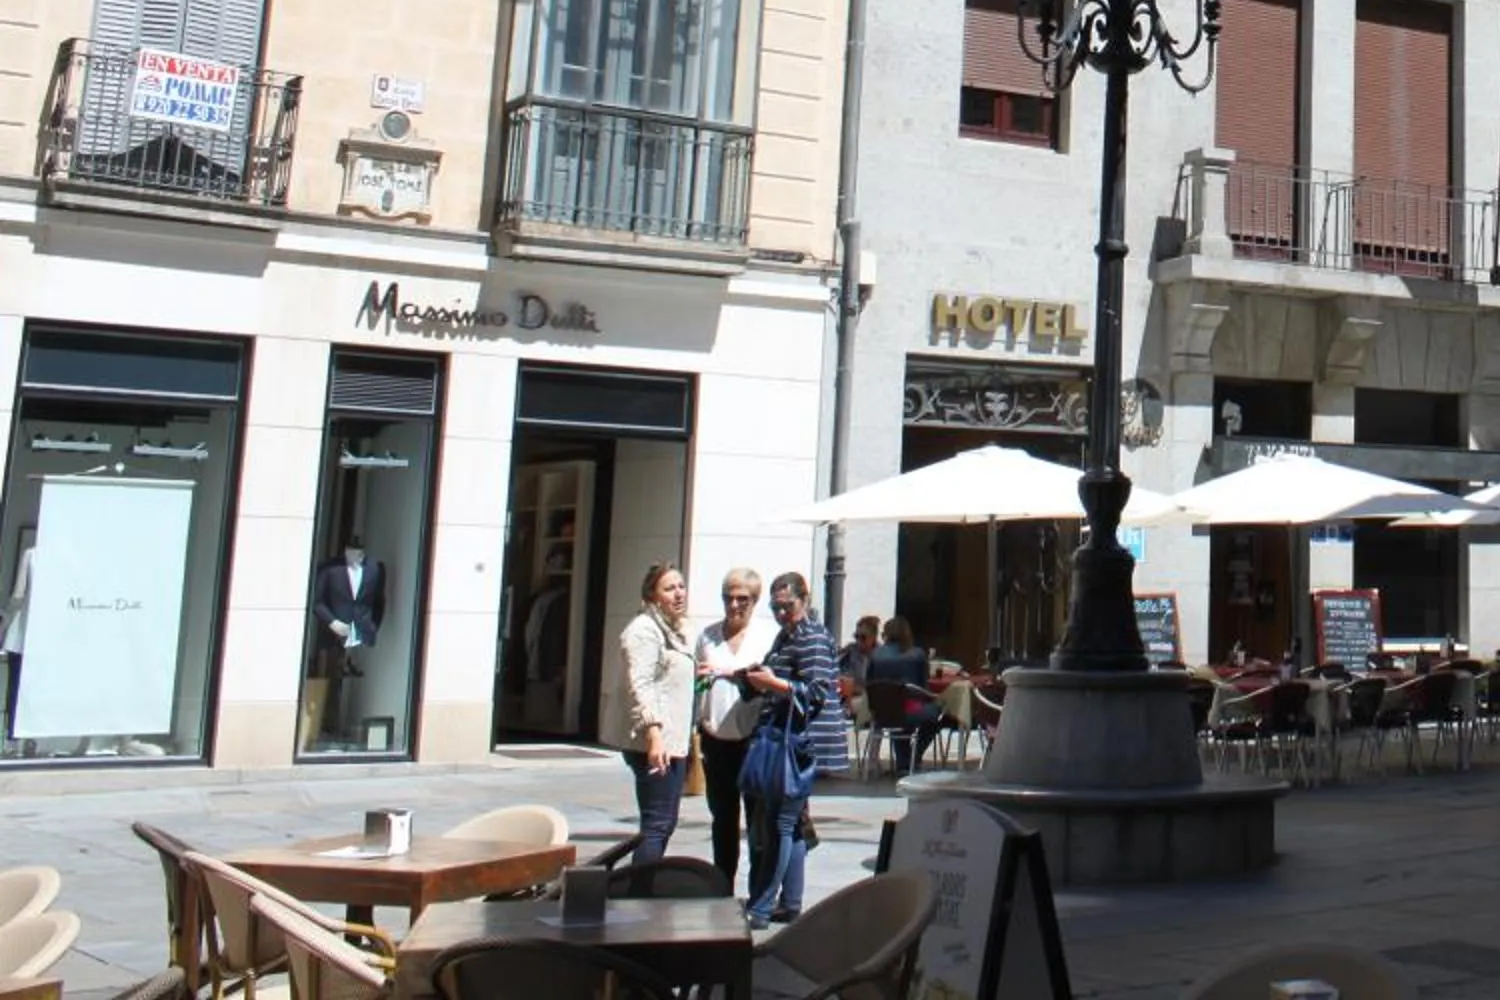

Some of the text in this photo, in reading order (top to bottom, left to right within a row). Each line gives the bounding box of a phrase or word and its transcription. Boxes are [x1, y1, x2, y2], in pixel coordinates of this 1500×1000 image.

[143, 52, 235, 84] EN VENTA
[356, 280, 603, 333] Massimo Dutti
[933, 294, 1089, 339] HOTEL
